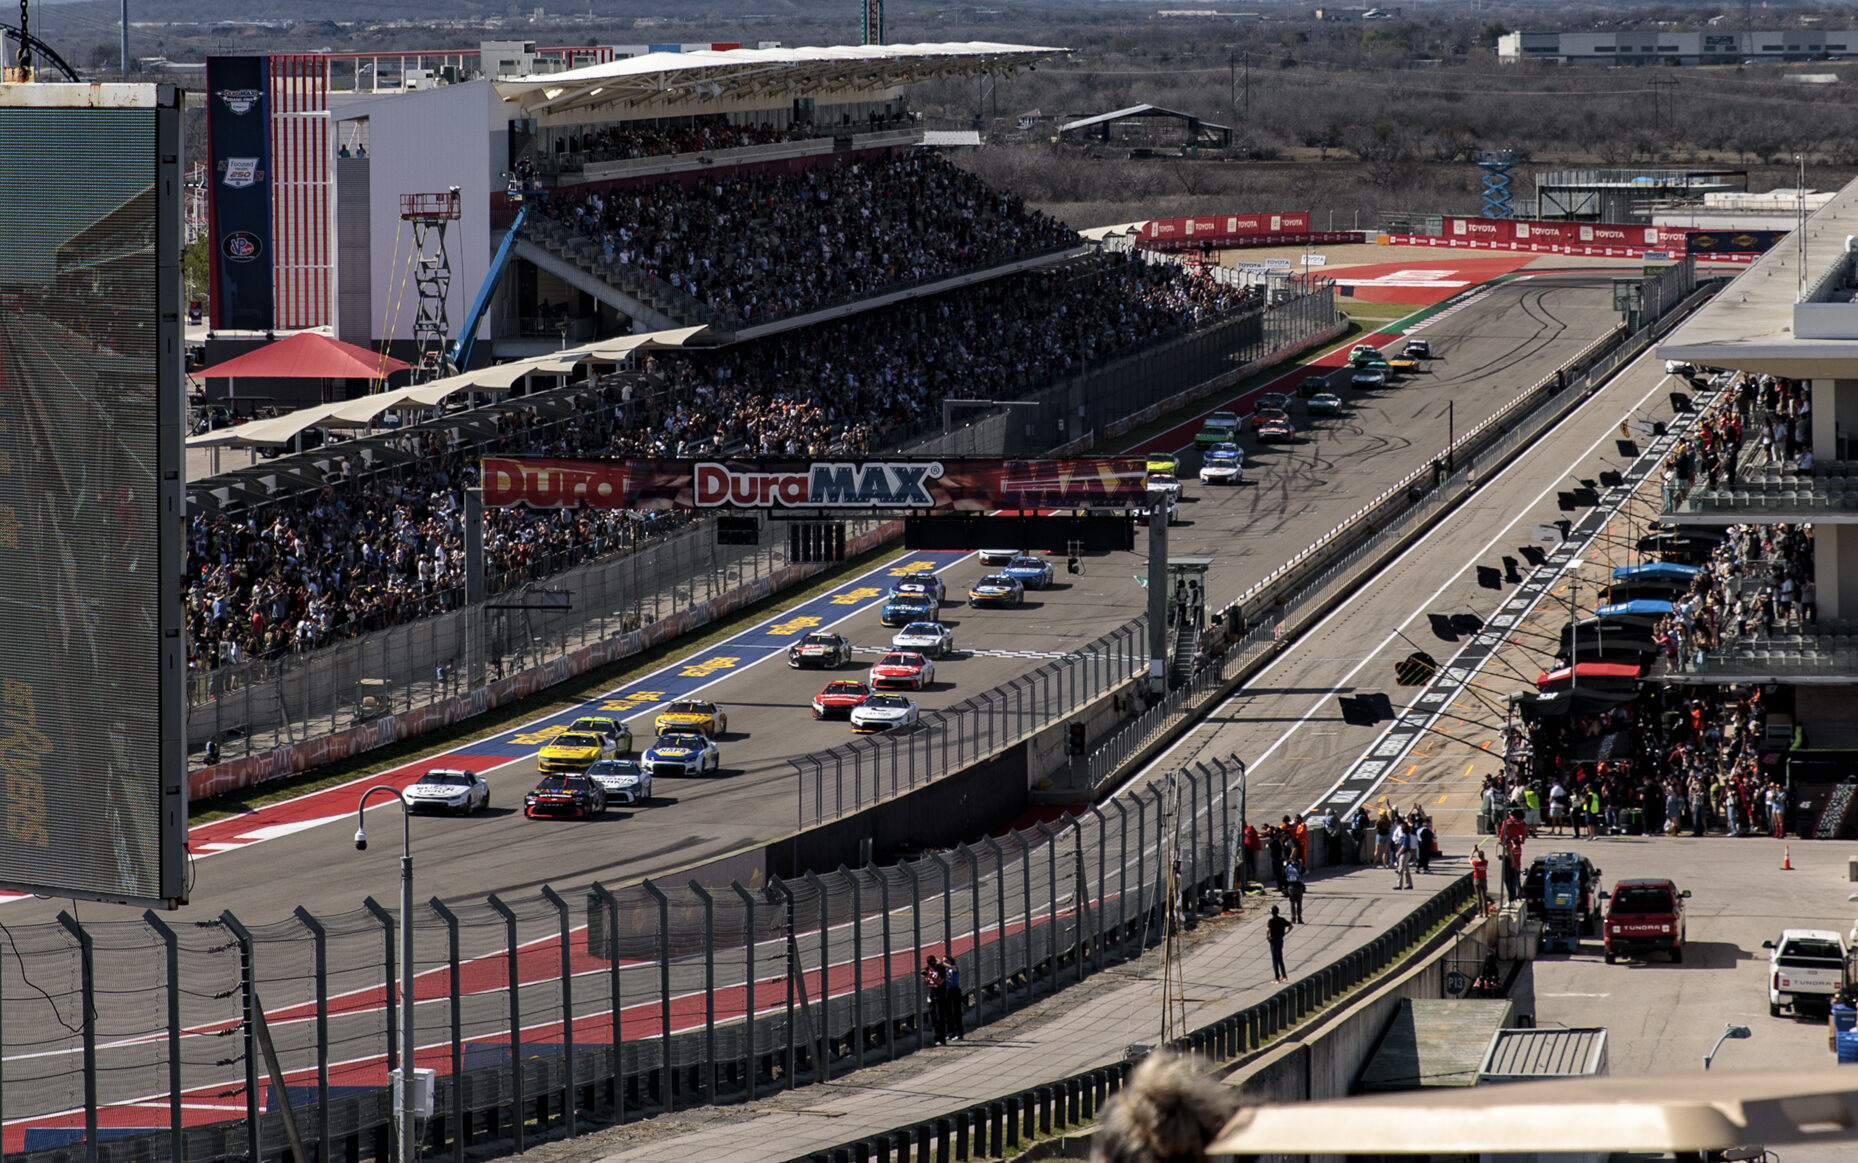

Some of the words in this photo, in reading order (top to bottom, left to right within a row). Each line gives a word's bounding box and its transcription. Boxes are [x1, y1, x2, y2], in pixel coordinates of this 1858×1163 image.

[1195, 222, 1215, 231] TOYOTA
[1237, 220, 1258, 229] TOYOTA
[1282, 219, 1303, 227] TOYOTA
[1158, 225, 1175, 233] TOYOTA
[1467, 224, 1497, 233] TOYOTA
[1531, 227, 1561, 236] TOYOTA
[1595, 230, 1625, 239] TOYOTA
[1448, 978, 1464, 989] P13
